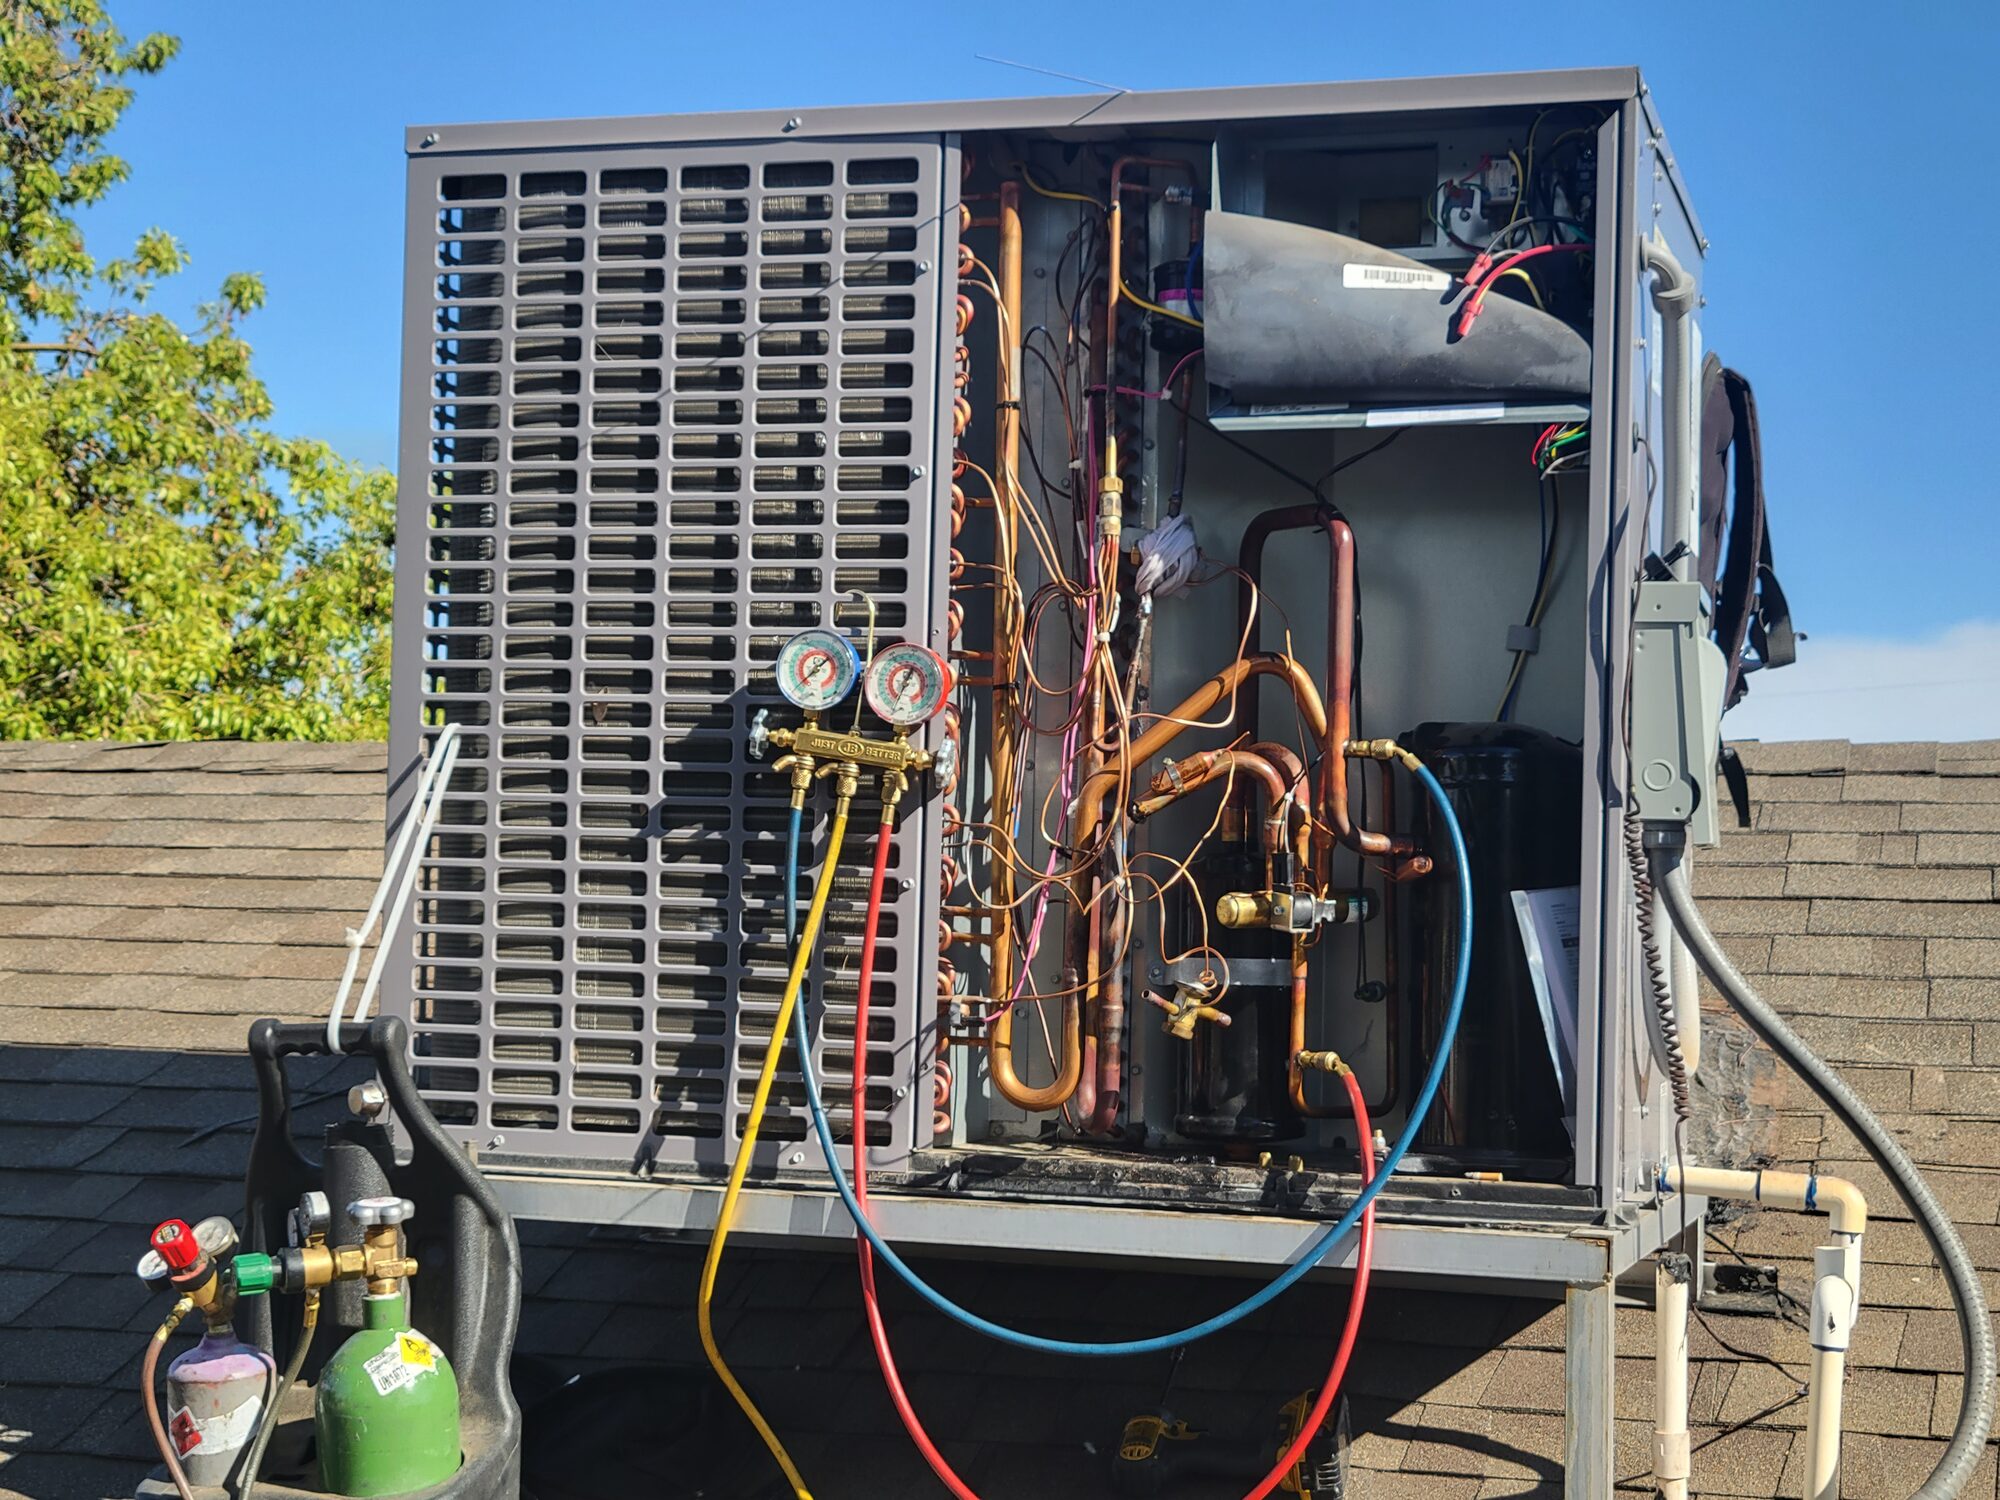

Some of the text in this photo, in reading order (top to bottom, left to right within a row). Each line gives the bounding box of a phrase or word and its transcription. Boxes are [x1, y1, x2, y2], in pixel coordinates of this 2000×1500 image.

[811, 738, 901, 761] JUST JB BETTER
